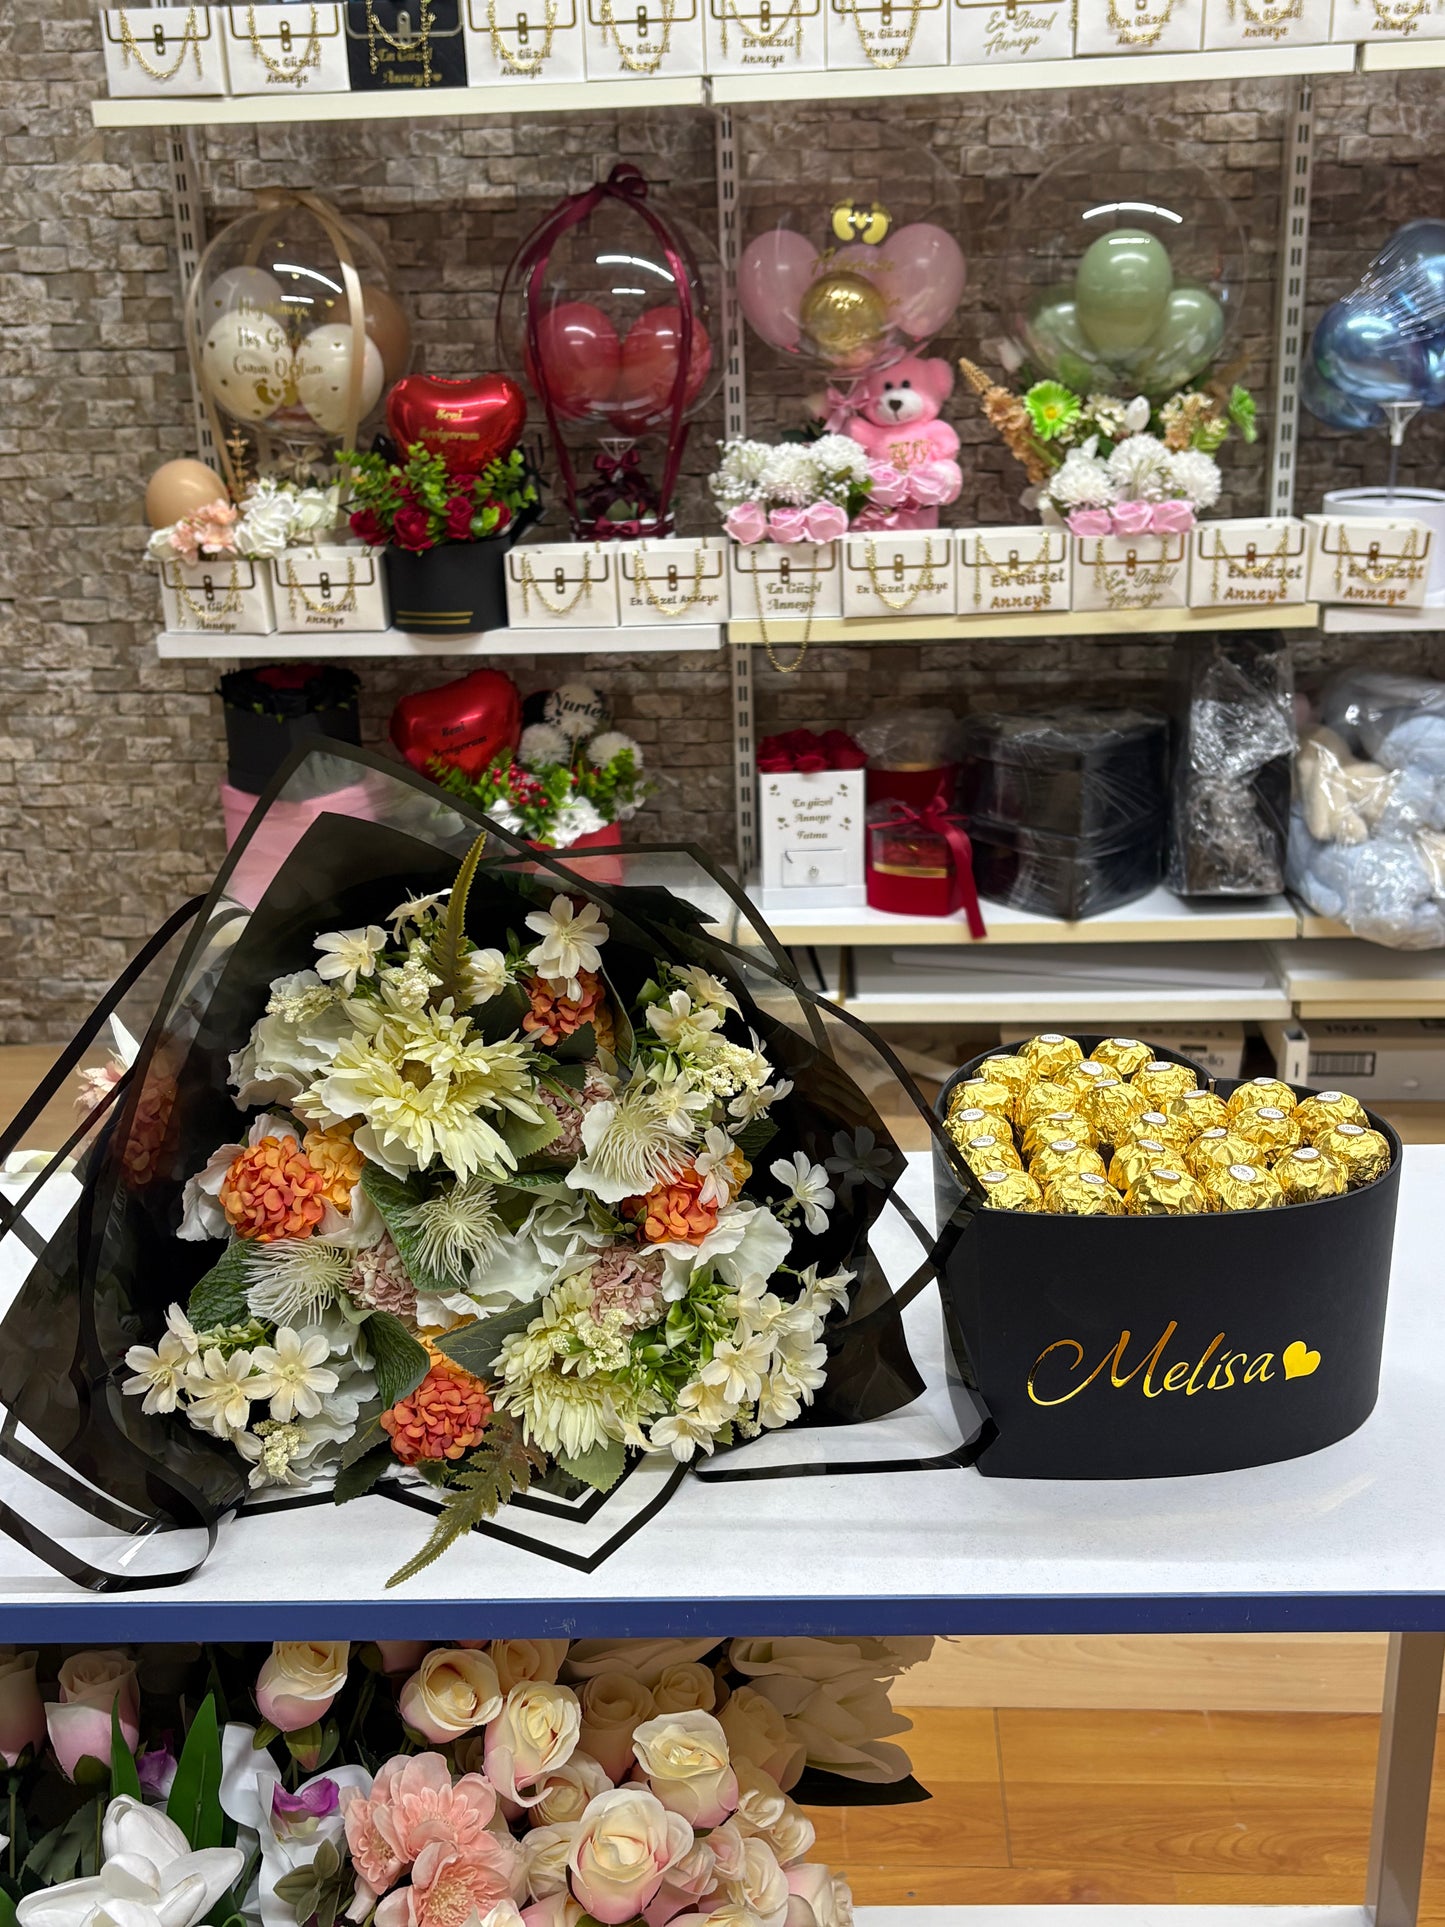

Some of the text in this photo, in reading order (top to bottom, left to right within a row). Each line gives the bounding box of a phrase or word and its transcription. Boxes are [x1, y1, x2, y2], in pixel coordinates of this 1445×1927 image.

[985, 9, 1058, 34] En Güzel
[983, 33, 1042, 56] Anneye
[765, 582, 784, 595] En
[990, 573, 1010, 588] En
[856, 584, 871, 595] En
[1342, 586, 1408, 606] Anneye
[629, 597, 644, 606] En
[989, 594, 1053, 612] Anneye
[791, 798, 806, 809] En
[1026, 1320, 1276, 1407] Melisa
